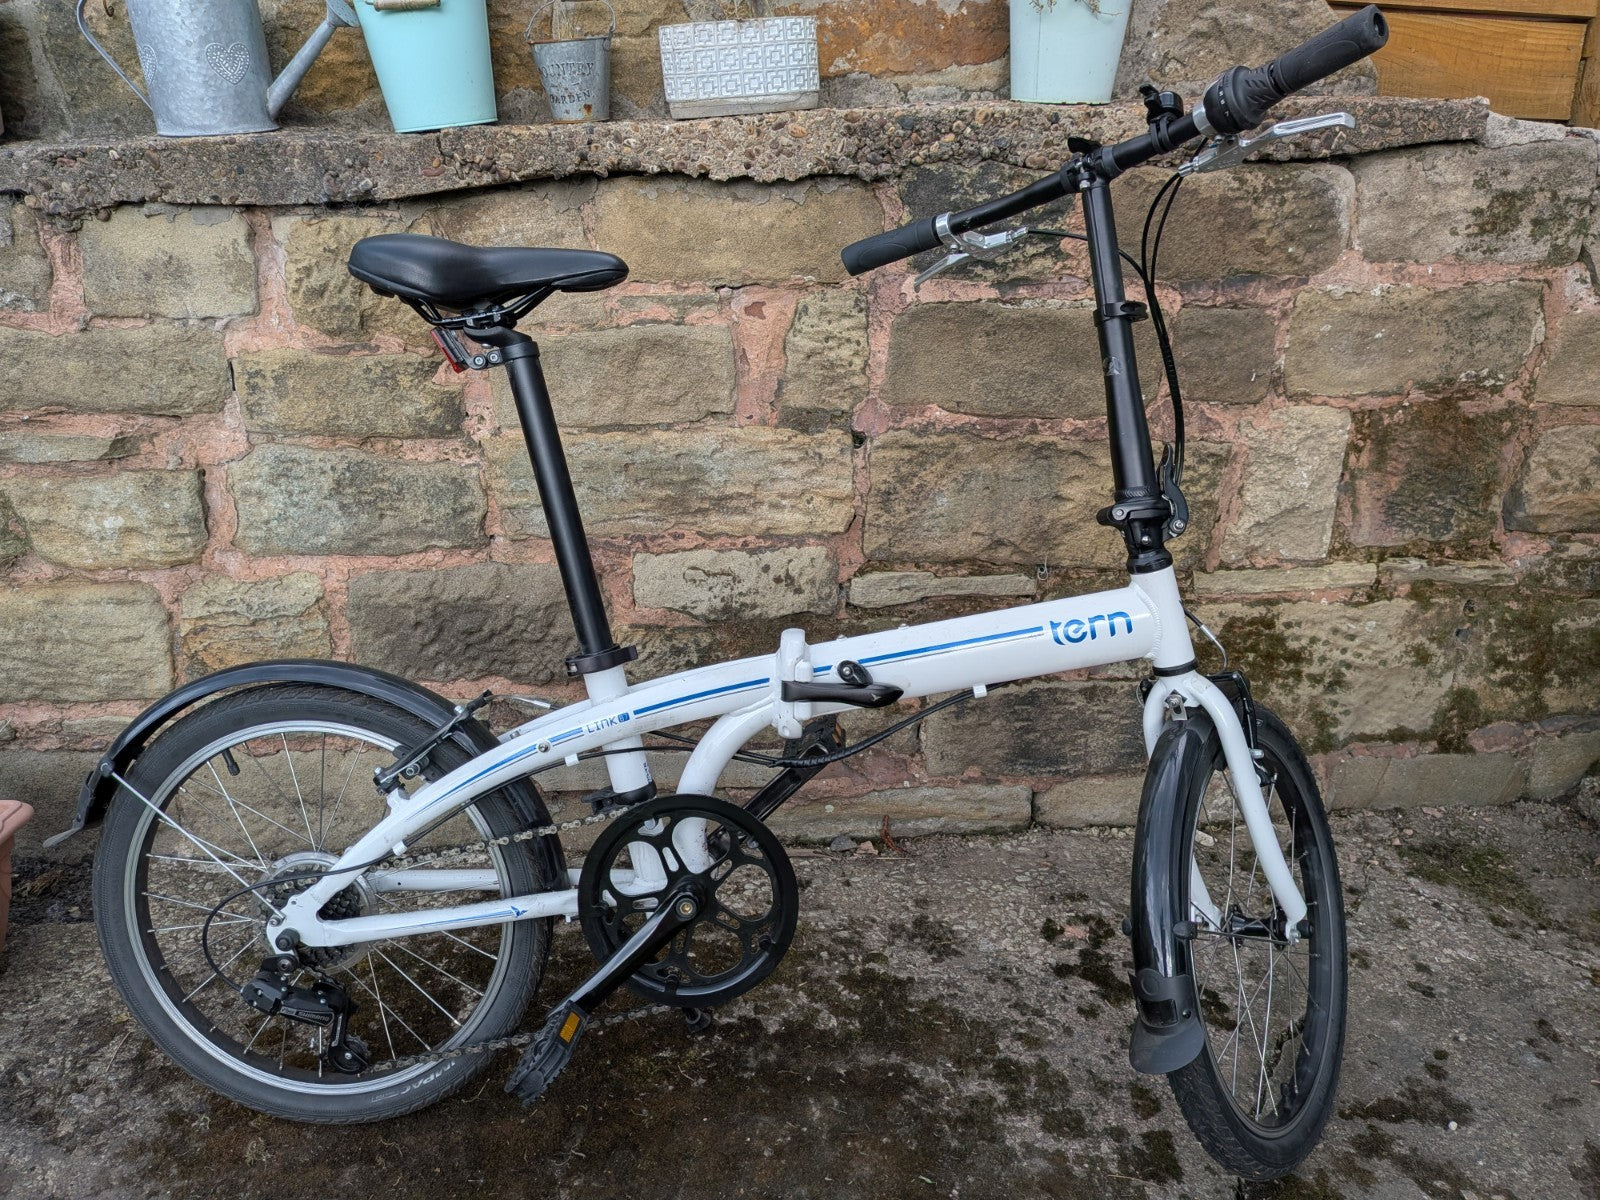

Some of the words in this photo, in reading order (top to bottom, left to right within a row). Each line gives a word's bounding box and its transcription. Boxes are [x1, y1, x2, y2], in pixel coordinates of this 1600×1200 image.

[550, 90, 590, 104] GARDEN
[1049, 611, 1133, 645] tern
[586, 716, 617, 733] LINK
